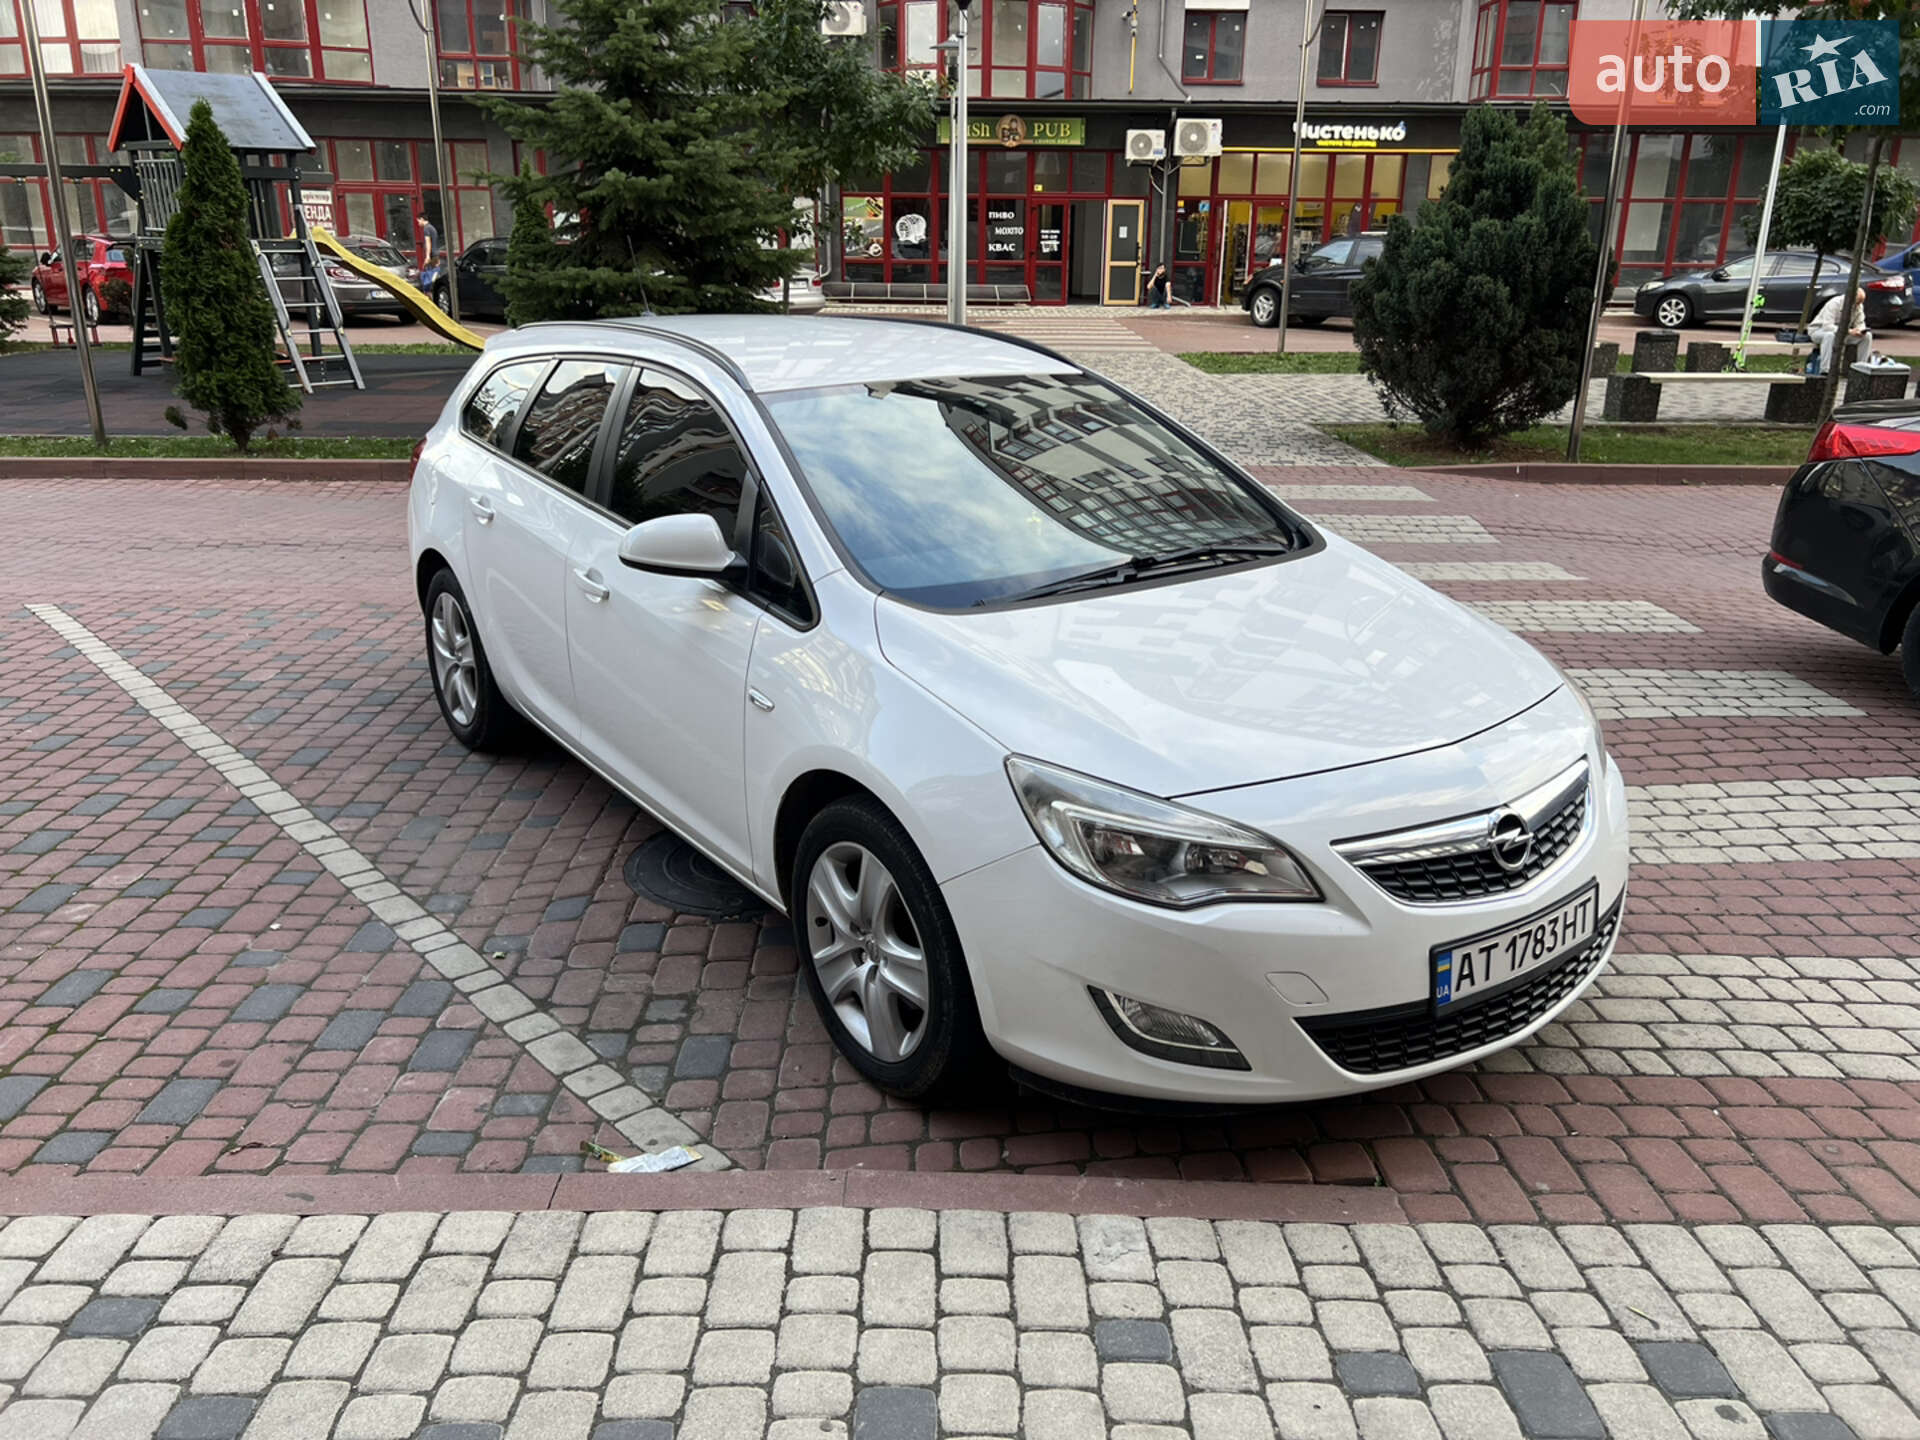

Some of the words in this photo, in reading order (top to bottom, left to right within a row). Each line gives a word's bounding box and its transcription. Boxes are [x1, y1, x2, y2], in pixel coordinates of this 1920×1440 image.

[1033, 122, 1071, 137] PUB
[988, 211, 1015, 220] ПИВО
[988, 243, 1015, 252] КВАС
[1437, 985, 1450, 998] UA
